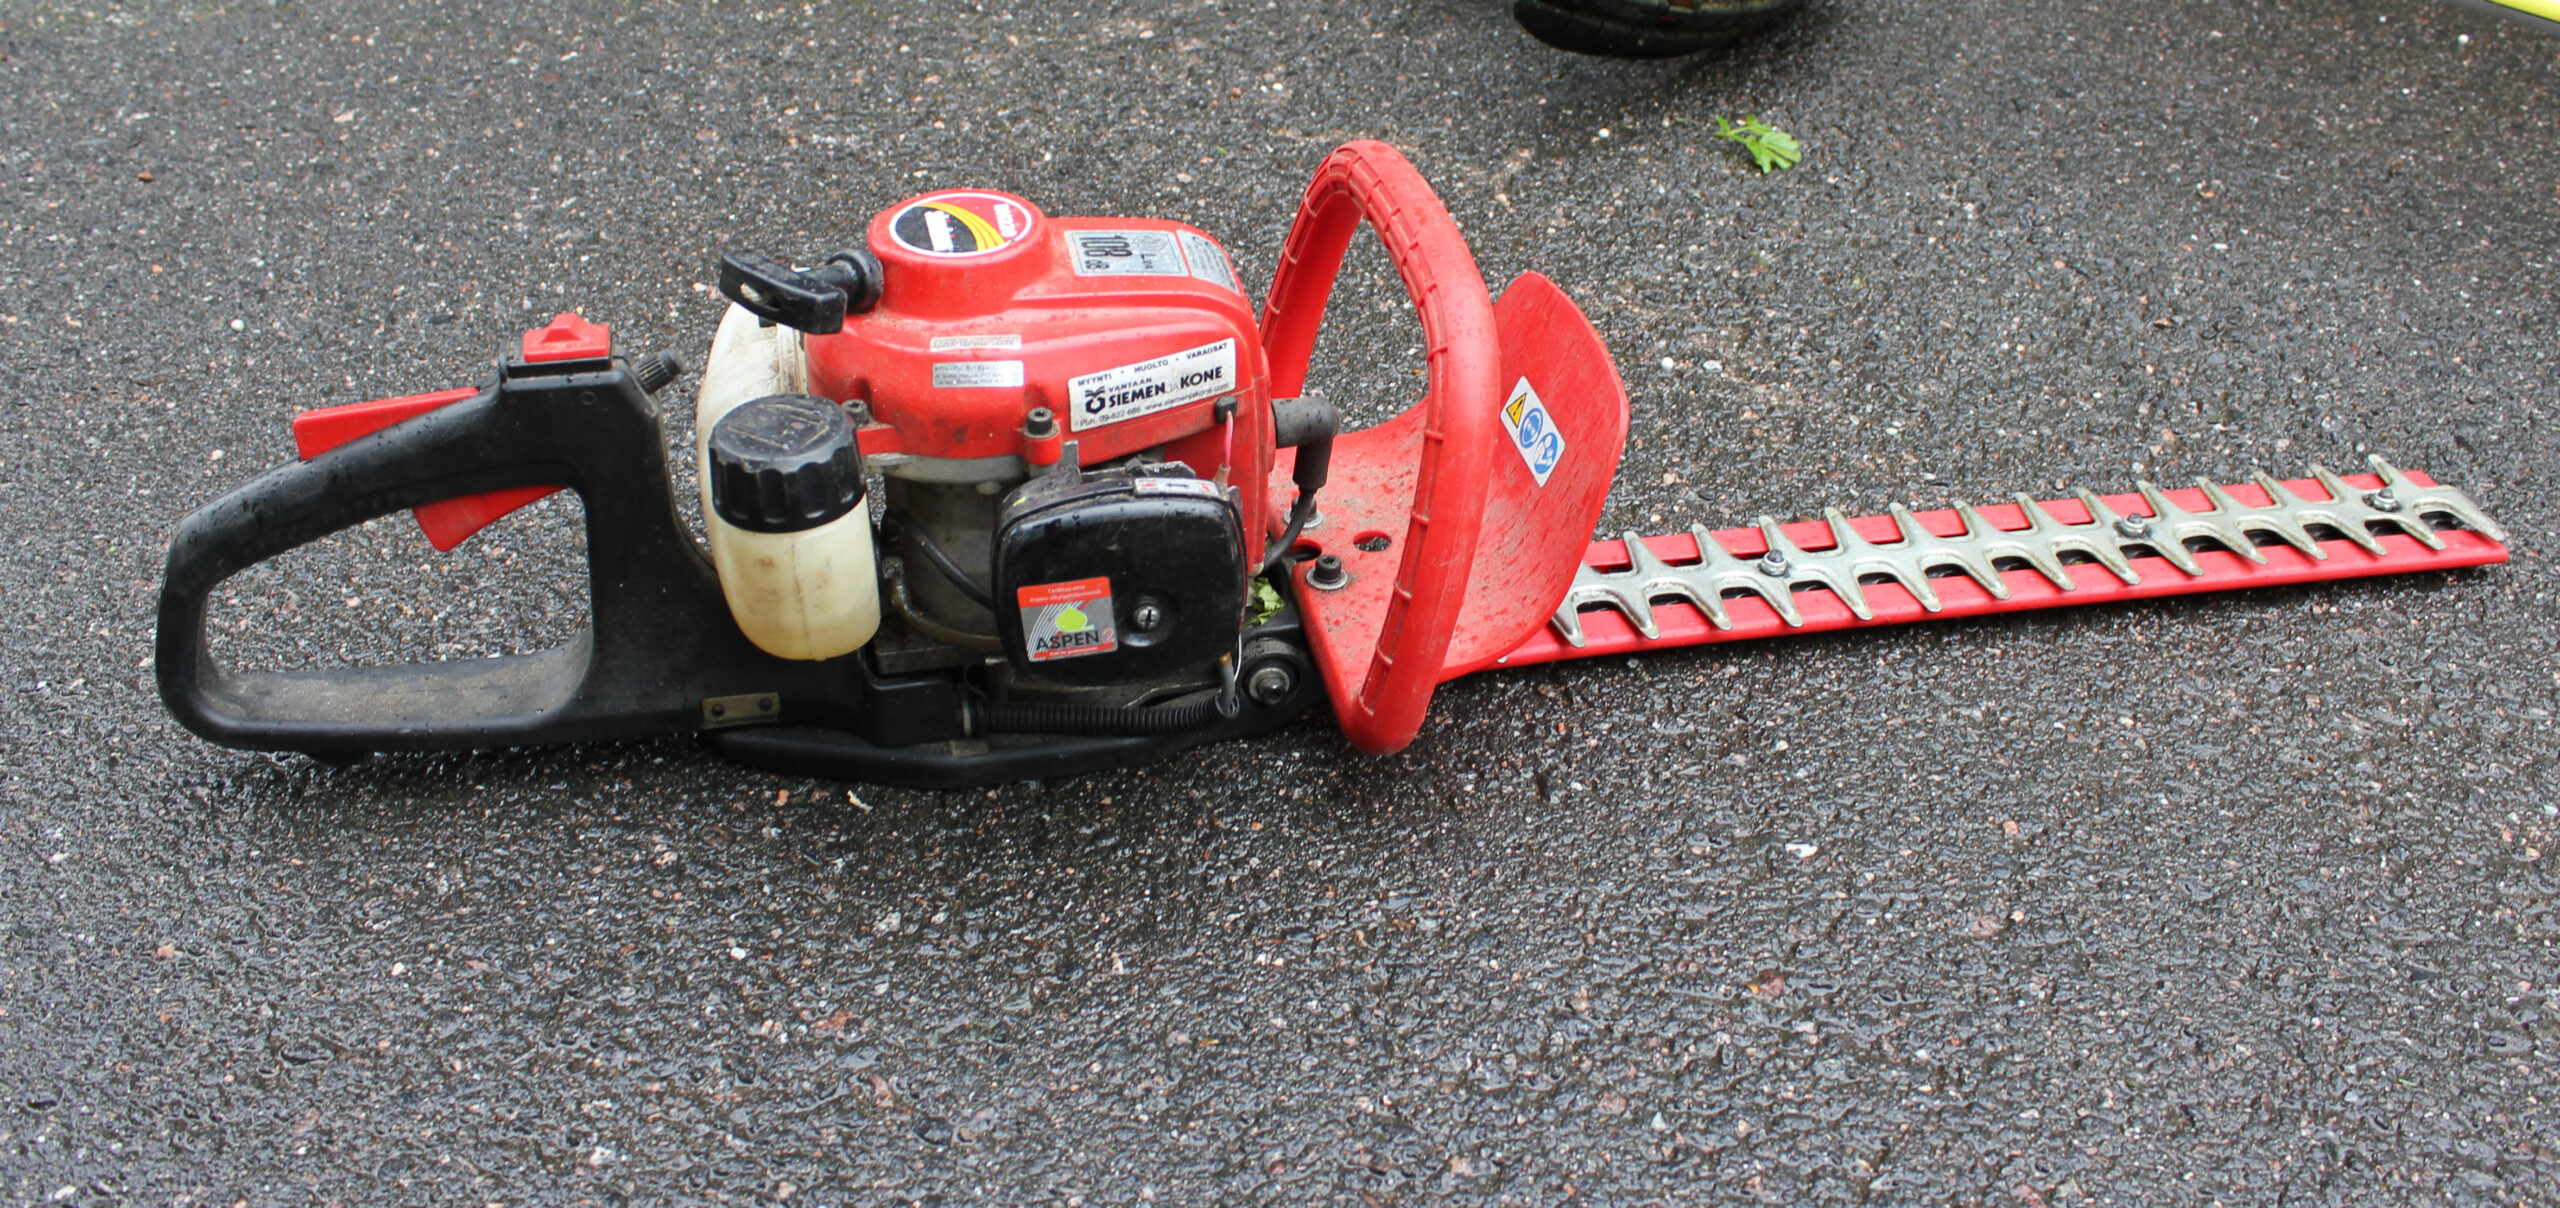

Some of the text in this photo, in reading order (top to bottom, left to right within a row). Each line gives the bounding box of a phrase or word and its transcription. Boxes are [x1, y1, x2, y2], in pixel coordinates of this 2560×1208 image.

[1080, 235, 1132, 257] 108
[1078, 343, 1228, 387] MYYNTI HUOLTO VARAOSAT
[1108, 377, 1152, 392] VANTAAN
[1108, 382, 1166, 408] SIEMEN
[1180, 366, 1223, 389] KONE
[1035, 627, 1115, 650] ASPEN 2
